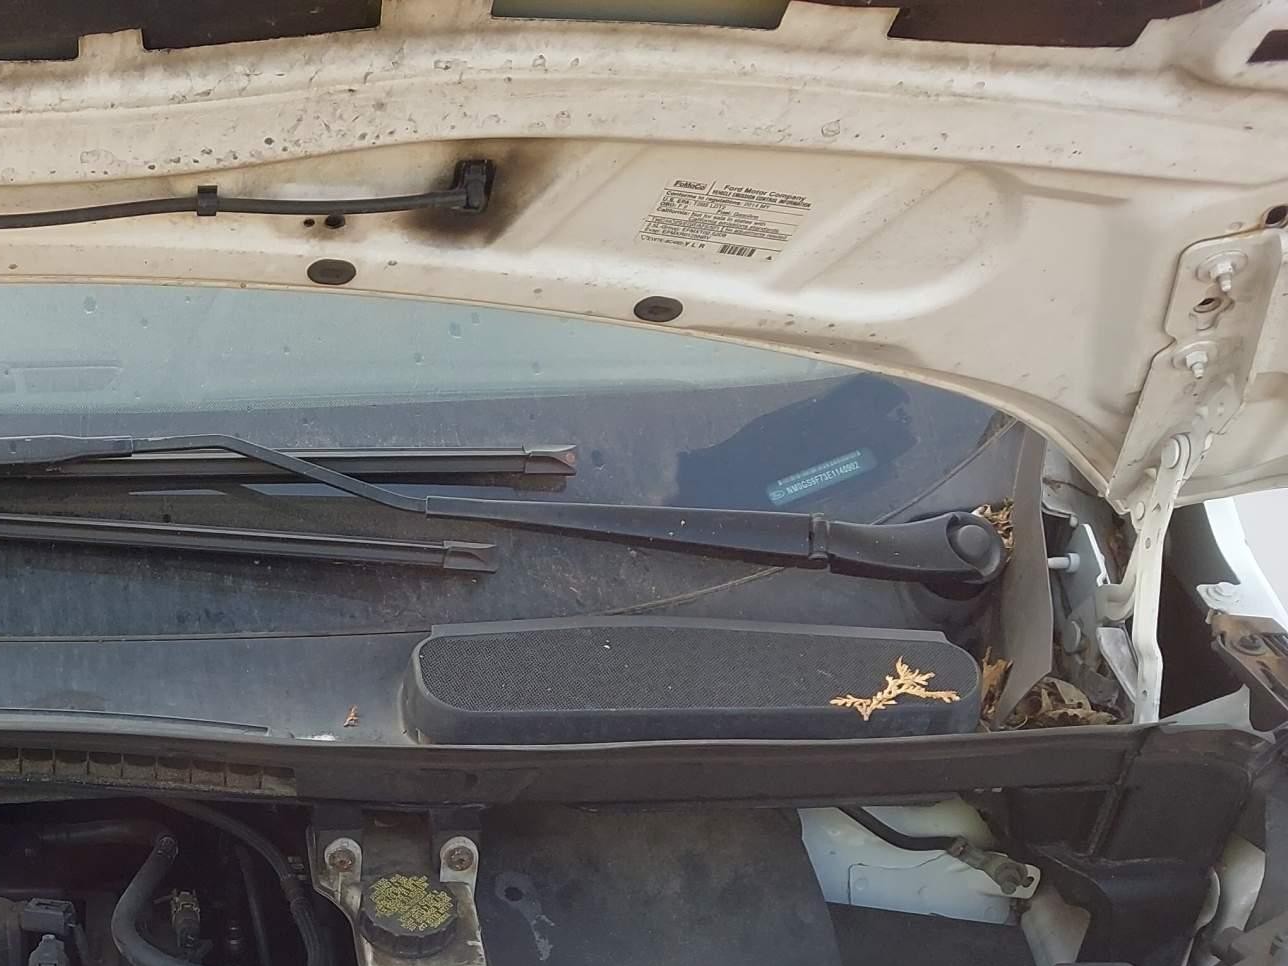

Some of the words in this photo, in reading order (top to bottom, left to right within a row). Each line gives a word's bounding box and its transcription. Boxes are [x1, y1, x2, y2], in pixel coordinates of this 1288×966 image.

[723, 184, 743, 192] Ford
[744, 187, 767, 195] Motor
[769, 191, 806, 202] Company
